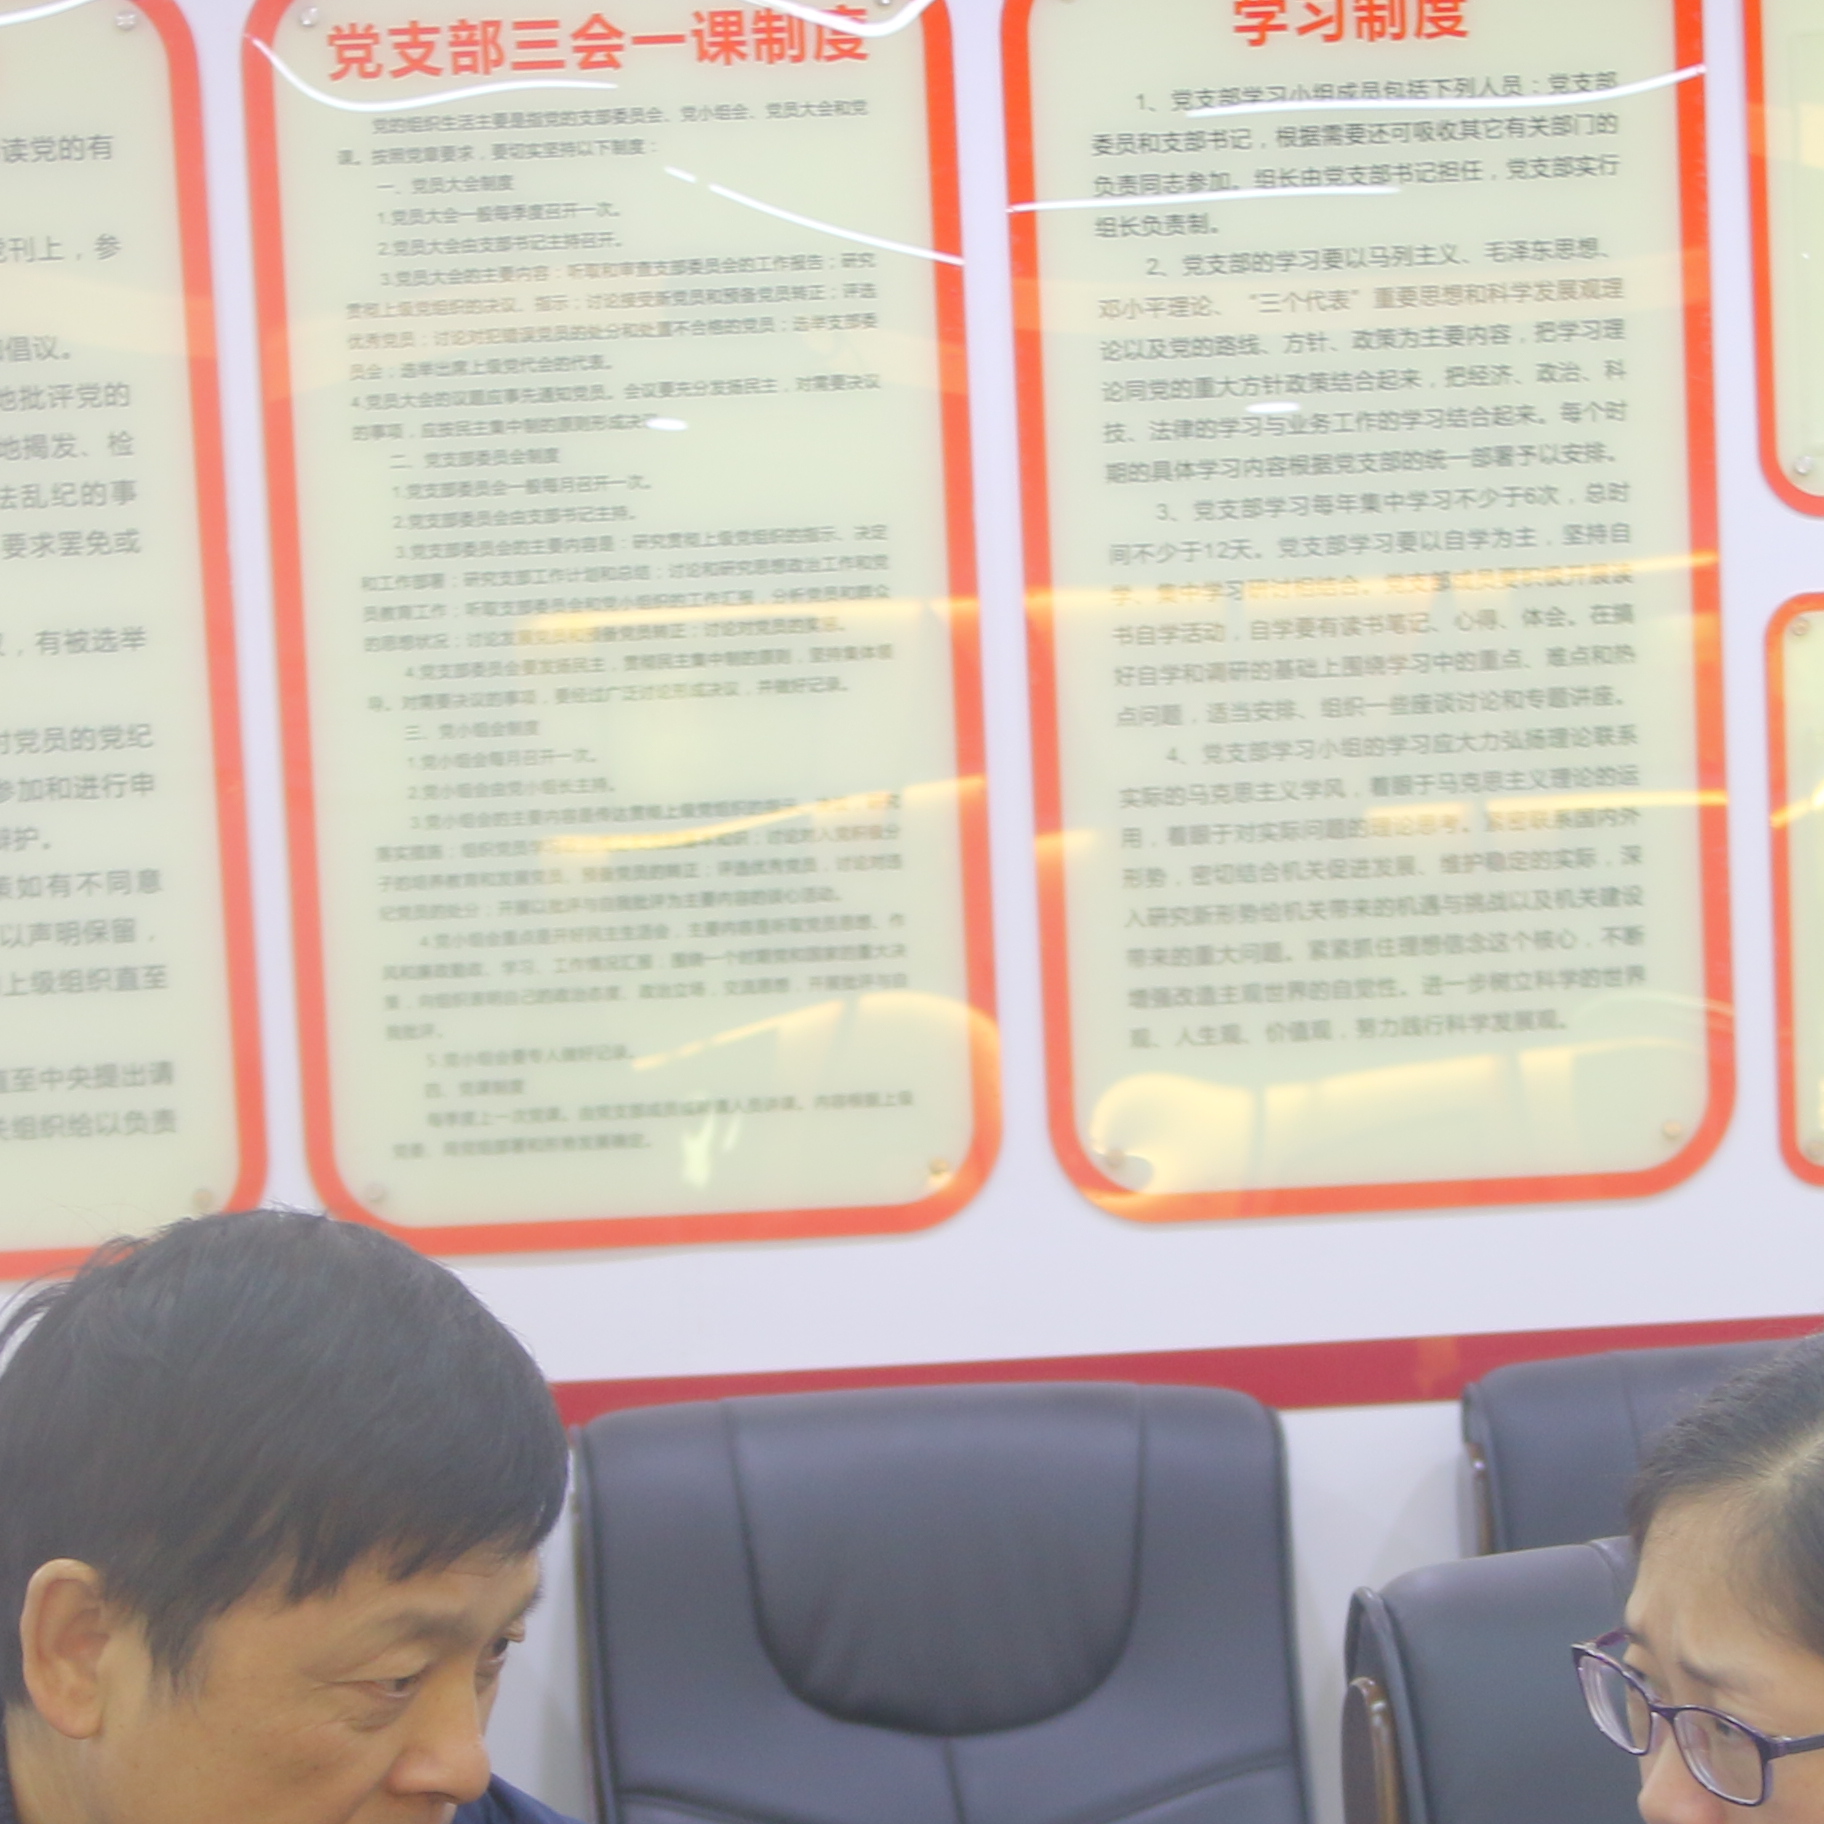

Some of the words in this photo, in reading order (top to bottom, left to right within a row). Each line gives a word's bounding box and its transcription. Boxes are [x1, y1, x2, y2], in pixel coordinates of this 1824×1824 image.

[327, 4, 868, 81] 党支部三会一课制度
[1233, 0, 1469, 47] 学习制度
[1133, 72, 1618, 110] 1、党支部学习小组成员包括下列人员：党支部
[1092, 113, 1619, 155] 委员和支部书记，根据需要还可吸收其它有关部门的
[376, 175, 513, 195] 一、党员大会制度
[1092, 155, 1620, 196] 负责同志参加。组长由党支部书记担任，党支部实行
[1094, 213, 1218, 238] 组长负责制。
[1145, 237, 1608, 277] 2、党支部的学习要以马列主义、毛泽东思想、
[1099, 319, 1625, 361] 论以及党的路线、方针、政策为主要内容，把学习理
[1101, 359, 1627, 402] 论同党的重大方针政策结合起来，把经济、政治、科
[352, 413, 659, 440] 的事项，应按民主集中制的原则形成决
[1103, 400, 1628, 443] 技、法律的学习与业务工作的学习结合起来。每个时
[1105, 441, 1615, 484] 期的具体学习内容根据党支部的统一部署予以安排。
[1156, 481, 1630, 522] 3、党支部学习每年集中学习不少于6次，总时
[1110, 522, 1630, 566] 间不少于12天。党支部学习要以自学为主，坚持自
